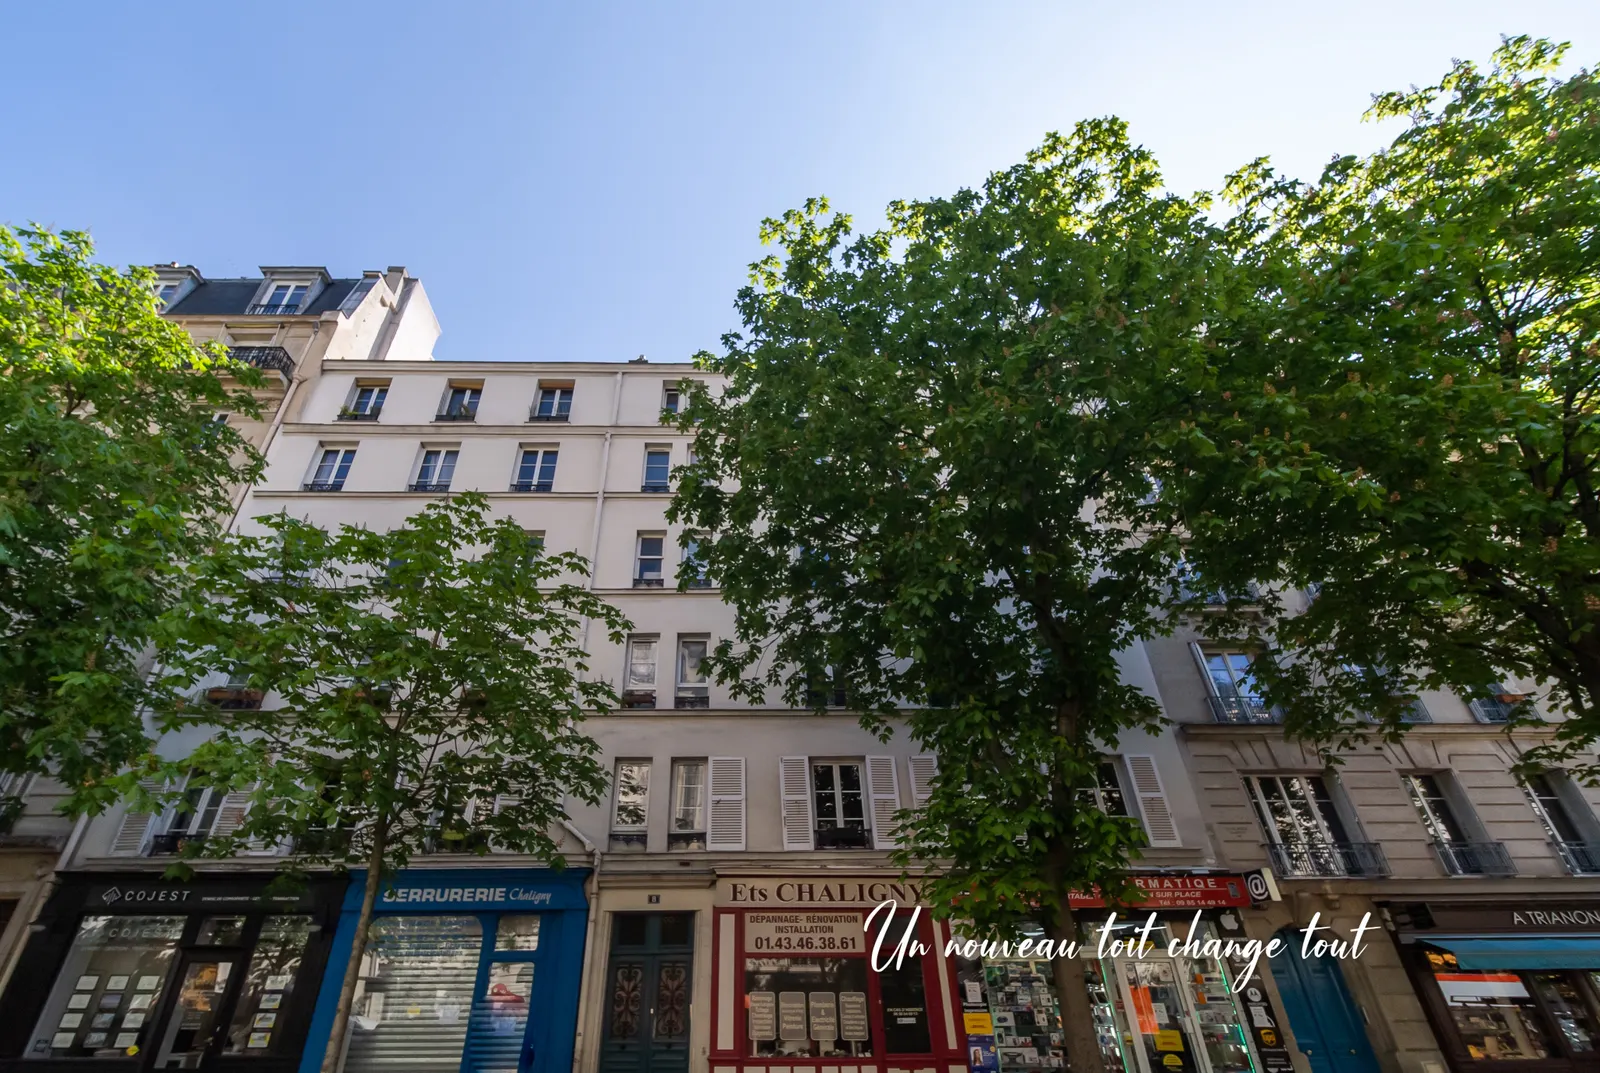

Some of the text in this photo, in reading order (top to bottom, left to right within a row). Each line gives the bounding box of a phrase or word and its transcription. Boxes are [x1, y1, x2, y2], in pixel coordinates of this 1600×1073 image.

[124, 890, 191, 901] COJEST
[383, 888, 552, 904] SERRURERIE Chaligny
[731, 883, 922, 904] Ets CHALIGNY
[806, 914, 858, 924] RÉNOVATION
[1513, 910, 1600, 925] A TRIANON
[775, 925, 834, 934] INSTALLATION
[755, 936, 857, 951] 01.43.46.38.61
